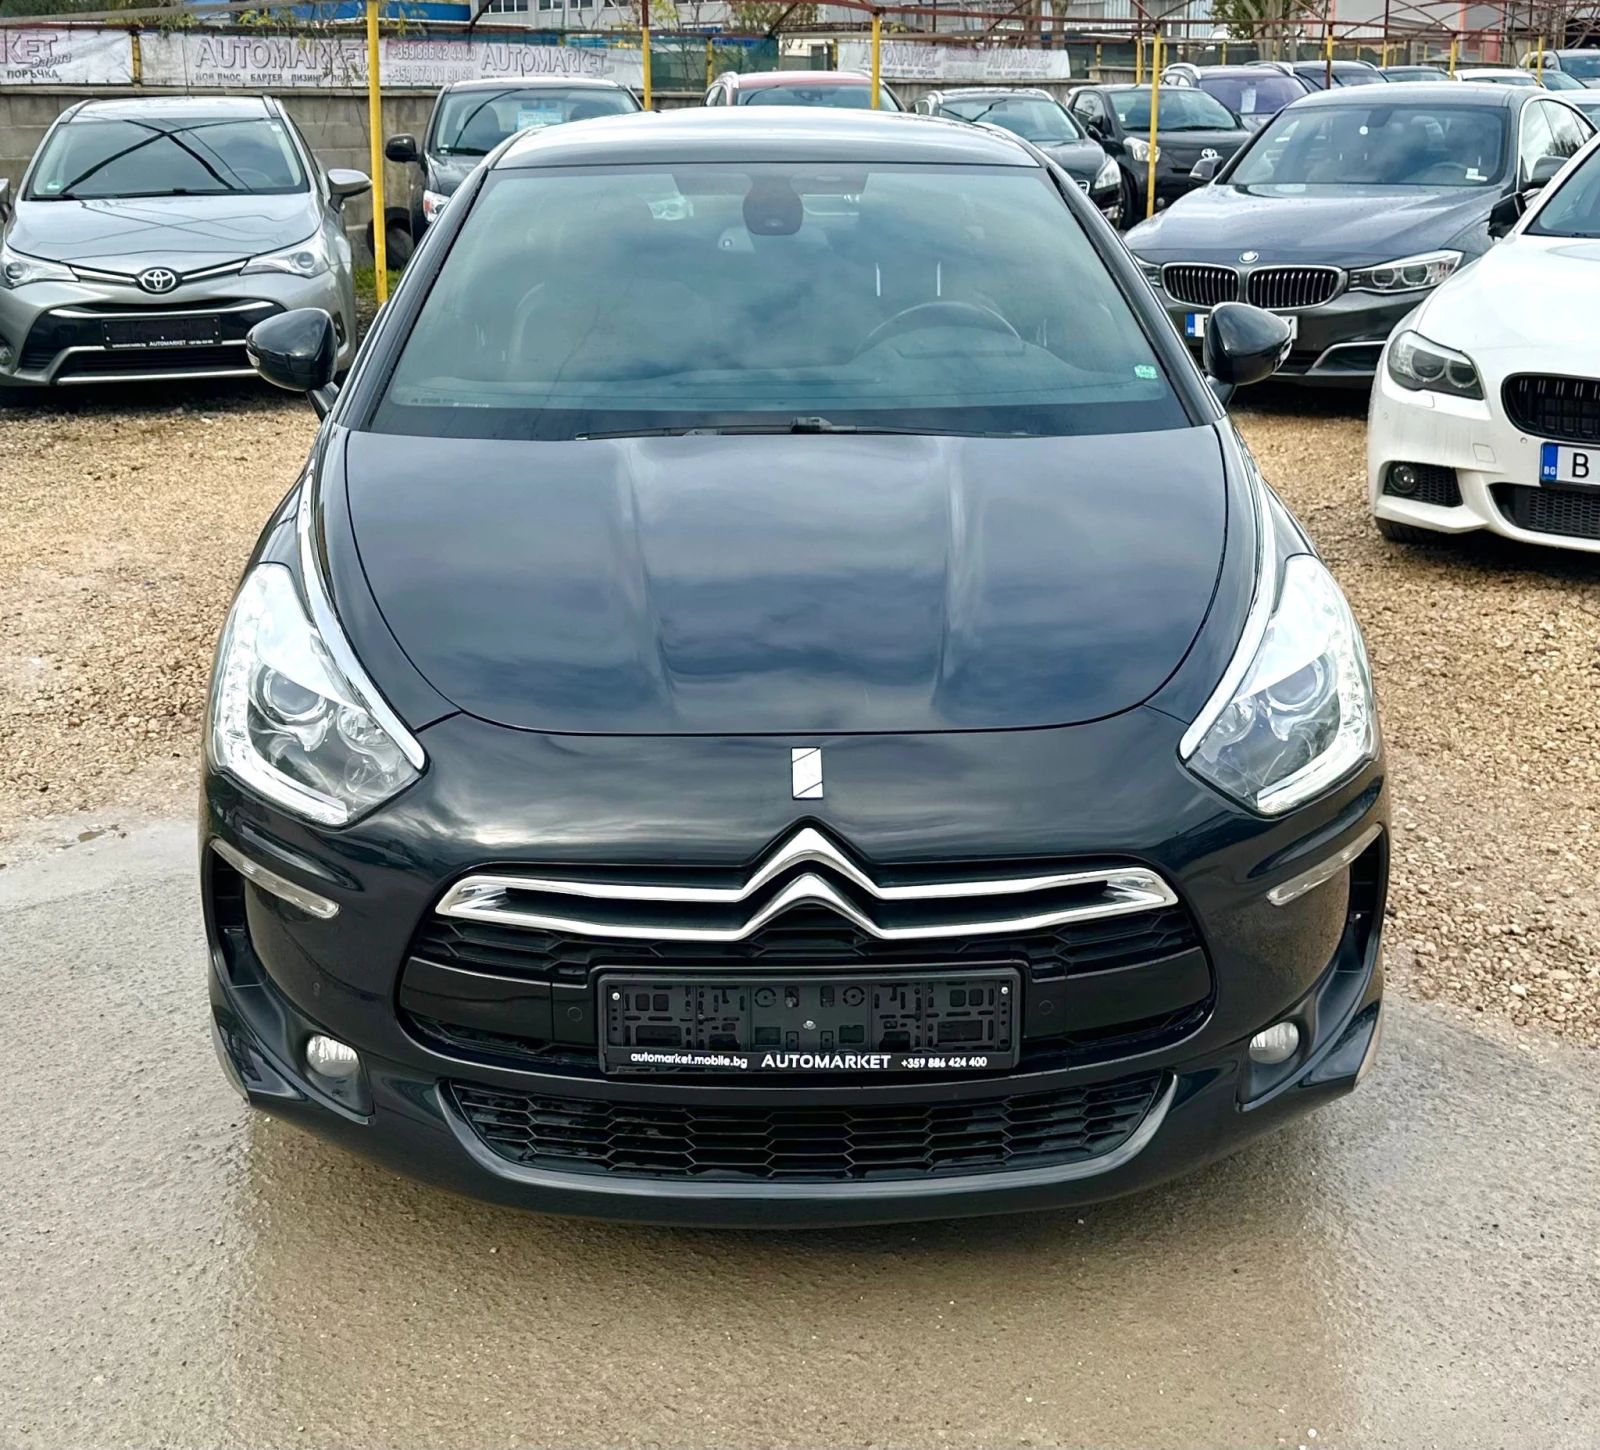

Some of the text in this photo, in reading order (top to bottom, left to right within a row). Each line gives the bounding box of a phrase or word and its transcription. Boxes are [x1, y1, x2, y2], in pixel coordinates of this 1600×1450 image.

[195, 38, 369, 70] AUTOMARKET
[481, 46, 608, 73] AUTOMARKET
[7, 69, 58, 79] ПОРЪЧКА
[250, 74, 283, 82] БАРТЕР
[1543, 466, 1556, 475] BG
[1572, 452, 1589, 478] B
[630, 1052, 988, 1069] automarket.mobile.bg AUTOMARKET +359 886 424 400
